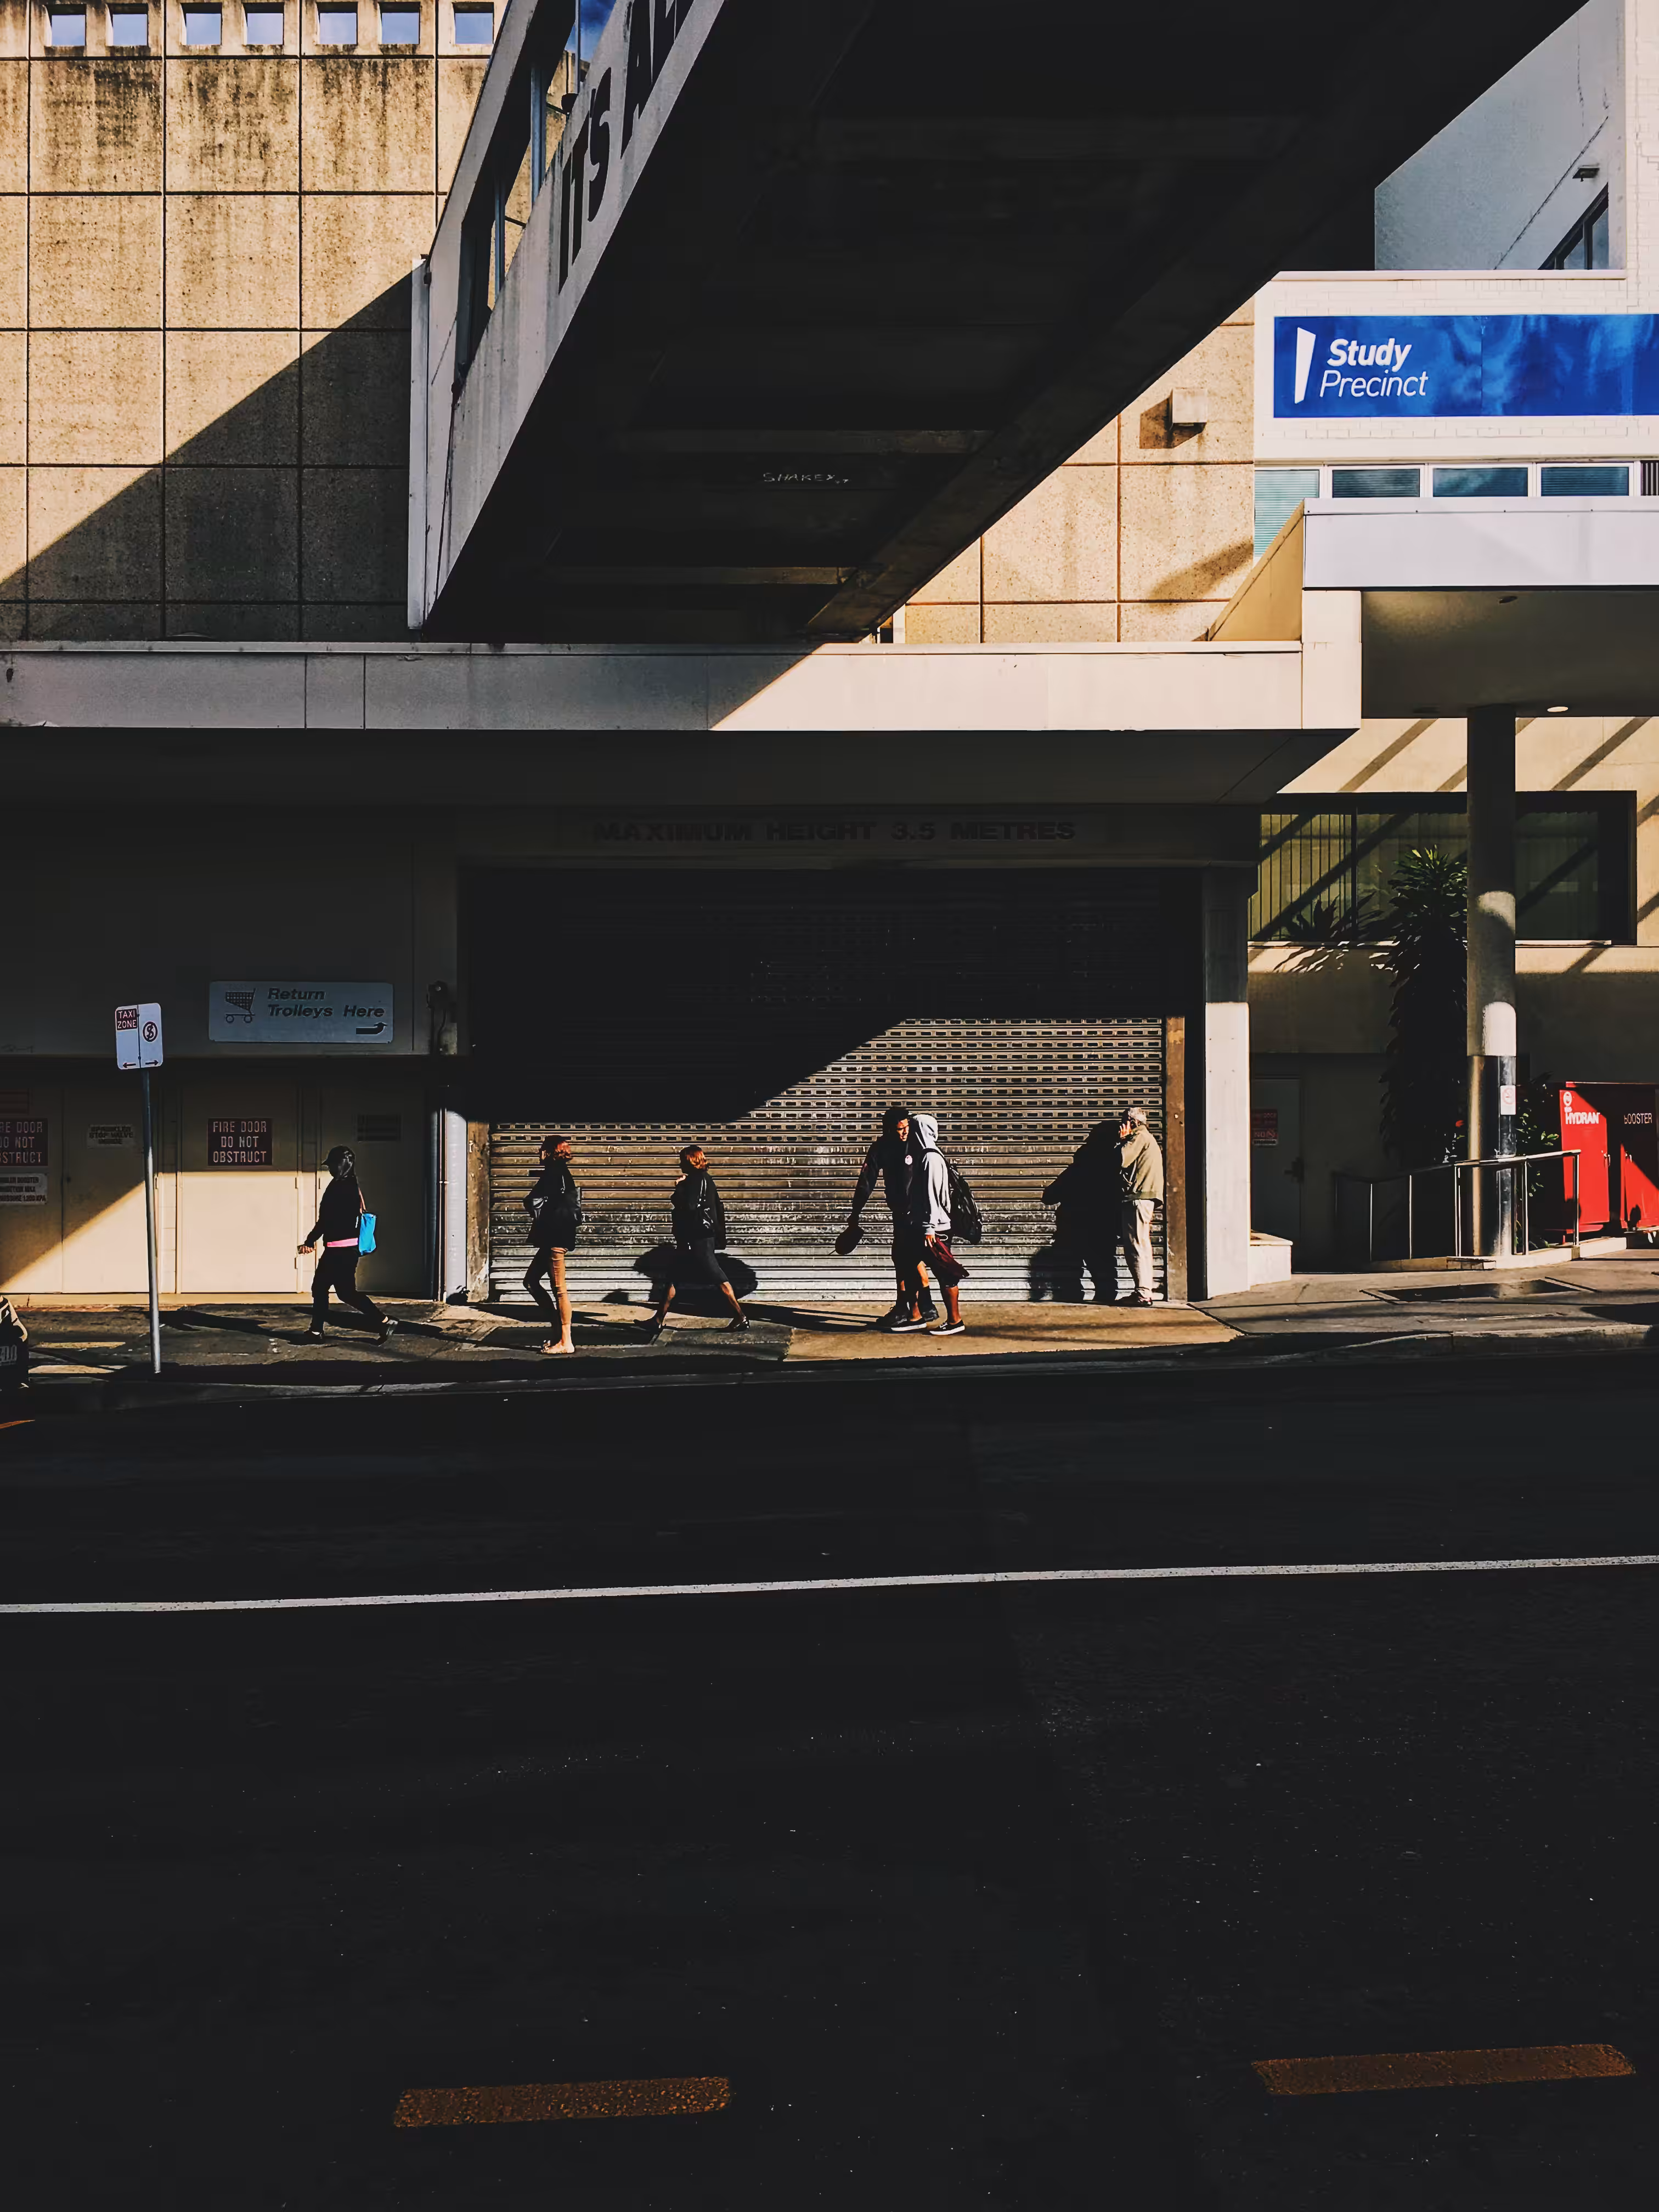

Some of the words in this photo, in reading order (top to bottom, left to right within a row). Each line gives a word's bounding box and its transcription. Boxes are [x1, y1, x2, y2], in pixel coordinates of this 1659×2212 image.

[558, 67, 612, 295] IT'S
[620, 0, 695, 160] AL
[1327, 338, 1412, 373] Study
[1319, 369, 1429, 397] Precinct
[596, 822, 752, 841] MAXIMUM
[766, 822, 877, 840] HEIGHT
[890, 822, 936, 840] 3.5
[951, 822, 1076, 840] METRES
[267, 988, 326, 1001] Return
[118, 1009, 136, 1019] TAXI
[268, 1004, 334, 1019] Trolleys
[343, 1005, 385, 1018] Here
[117, 1019, 137, 1029] ZONE
[16, 1121, 43, 1133] DOOR
[213, 1121, 235, 1133] FIRE
[241, 1121, 267, 1132] DOOR
[15, 1136, 35, 1148] NOT
[221, 1136, 233, 1148] DO
[239, 1136, 259, 1148] NOT
[0, 1151, 42, 1164] STRUCT
[213, 1150, 267, 1163] OBSTRUCT
